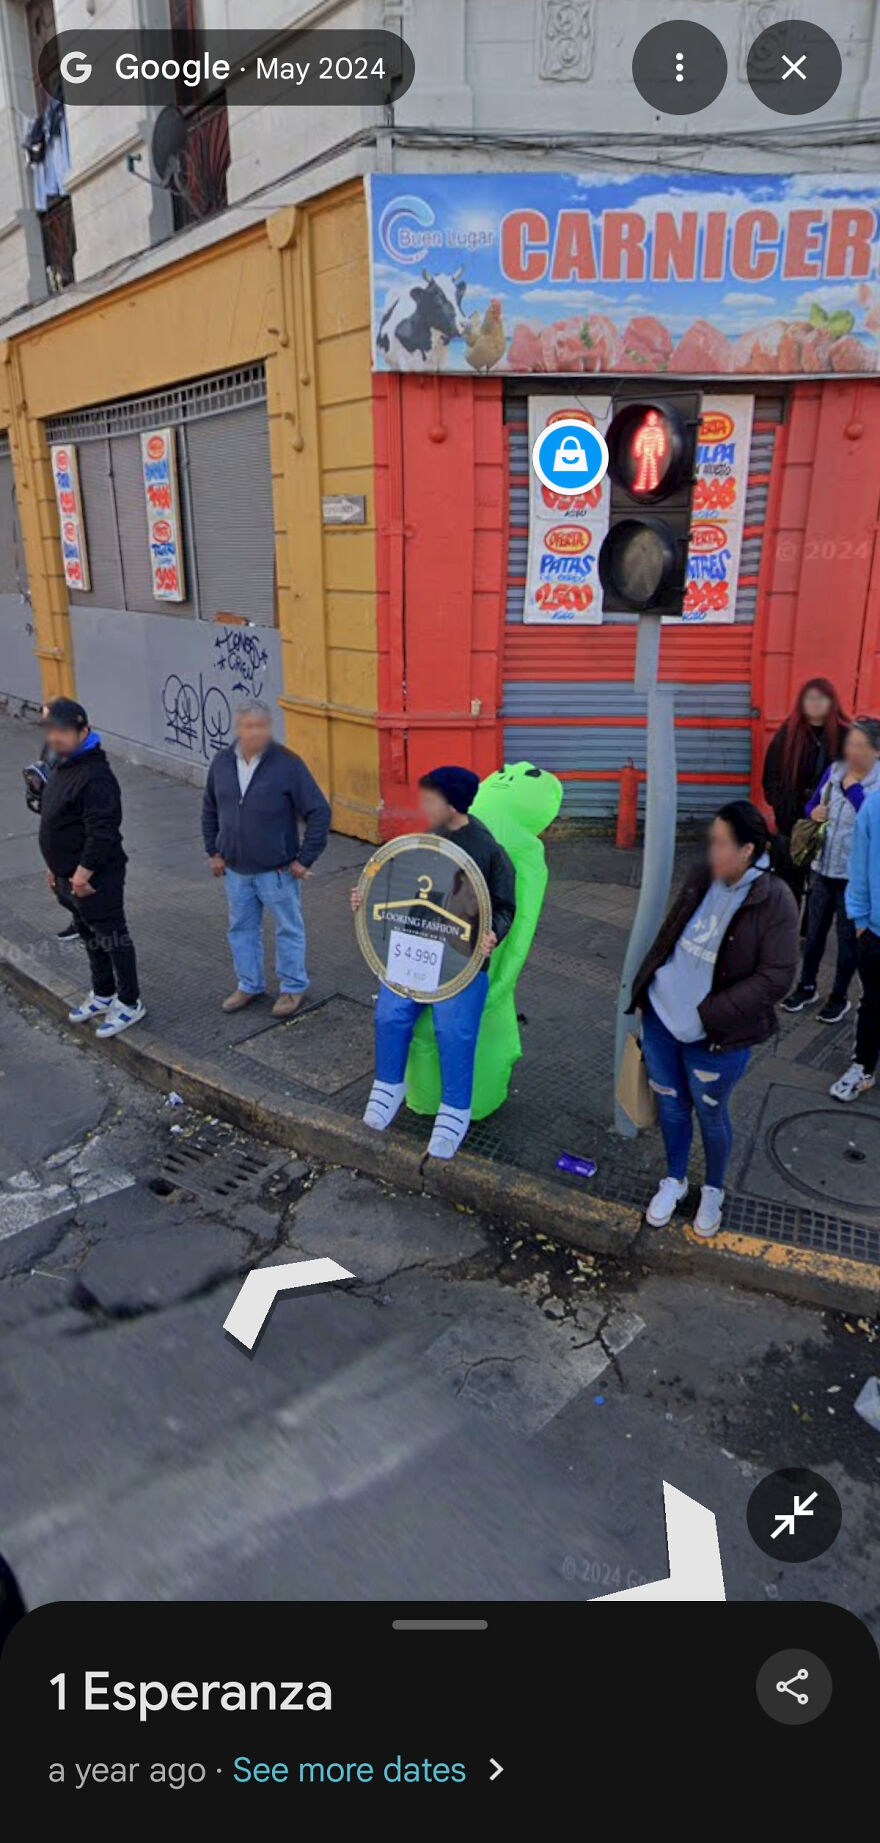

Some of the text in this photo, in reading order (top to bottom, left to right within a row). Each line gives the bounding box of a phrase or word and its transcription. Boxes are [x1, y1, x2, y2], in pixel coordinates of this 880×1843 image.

[399, 227, 443, 247] Buen
[500, 209, 880, 282] CARNICER
[690, 530, 722, 546] FERTA
[540, 554, 596, 577] PATAS
[381, 911, 420, 928] LOOKING
[421, 920, 460, 936] FASHION
